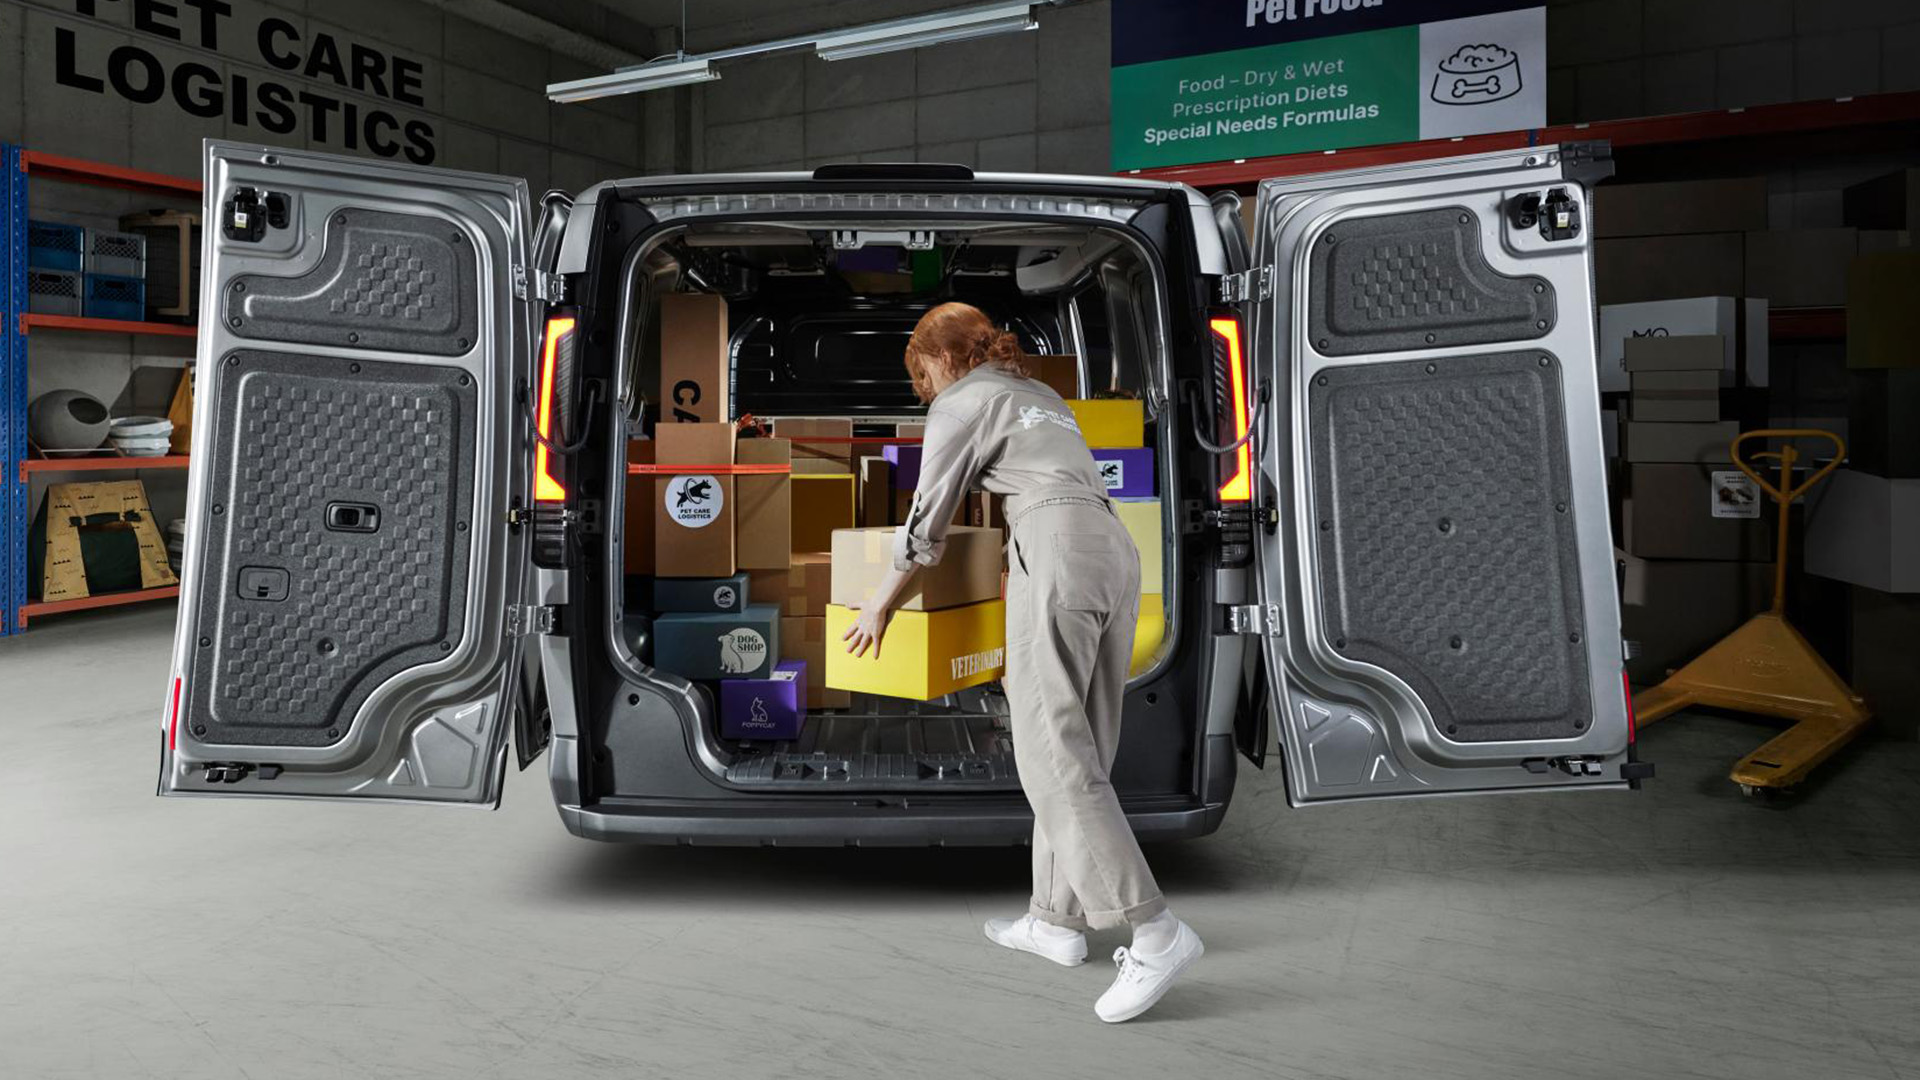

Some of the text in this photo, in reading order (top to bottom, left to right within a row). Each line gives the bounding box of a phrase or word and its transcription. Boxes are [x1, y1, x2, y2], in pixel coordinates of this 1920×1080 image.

[75, 0, 425, 107] ET CARE
[1178, 74, 1225, 95] Food
[1244, 69, 1278, 88] Dry
[1284, 63, 1298, 79] &
[1302, 58, 1345, 77] Wet
[55, 27, 436, 165] LOGISTICS
[1173, 81, 1348, 118] Prescription Diets
[1143, 102, 1380, 146] Special Needs Formulas
[737, 635, 757, 643] DOG
[737, 644, 764, 652] SHOP
[951, 647, 1004, 680] VETERINARY
